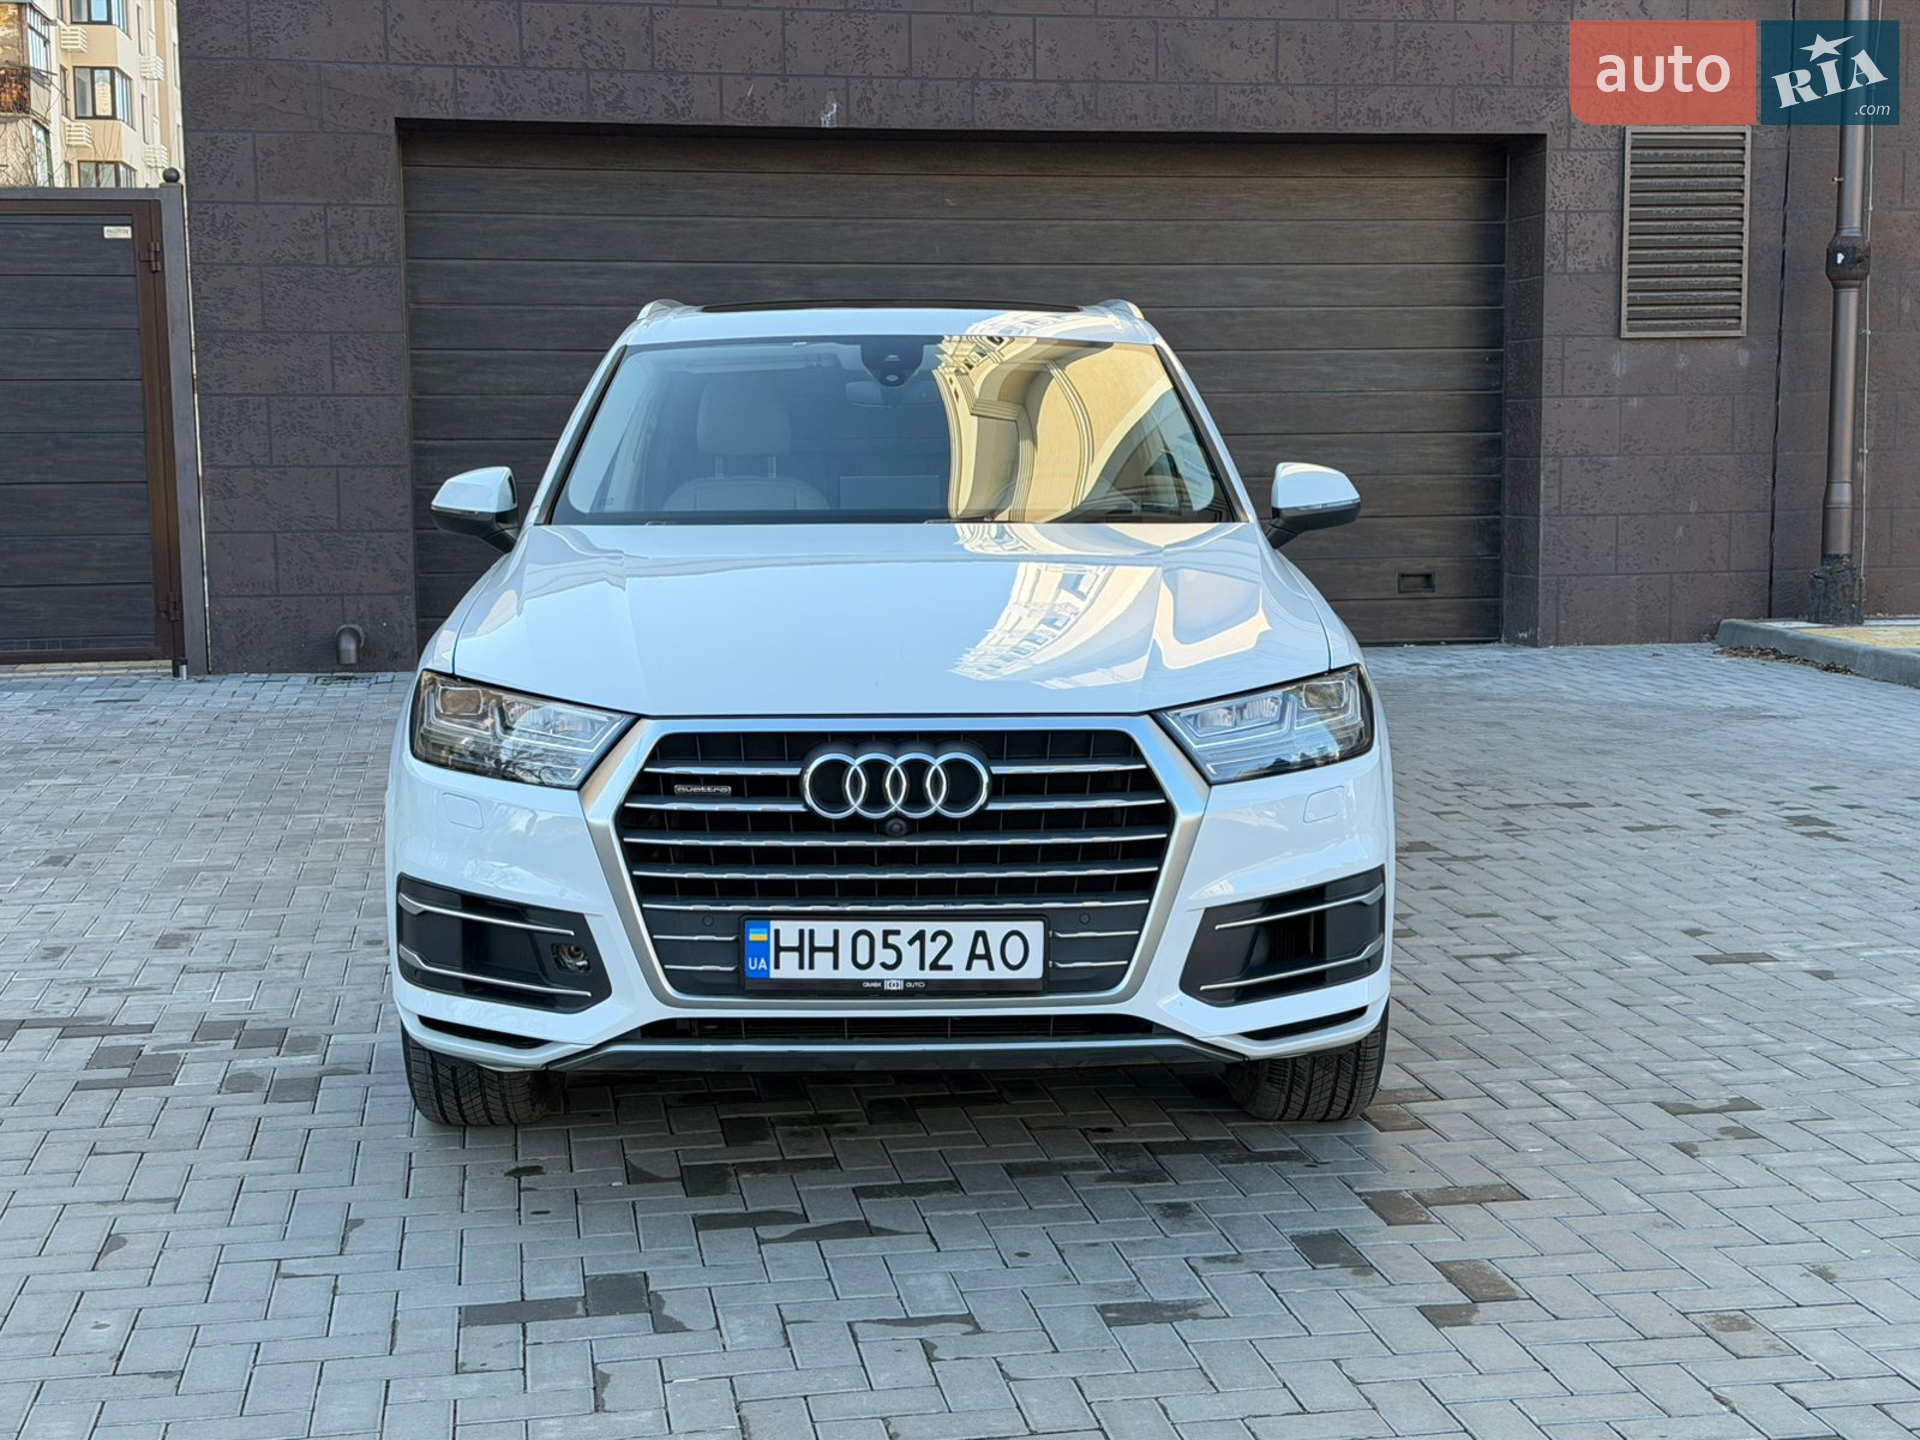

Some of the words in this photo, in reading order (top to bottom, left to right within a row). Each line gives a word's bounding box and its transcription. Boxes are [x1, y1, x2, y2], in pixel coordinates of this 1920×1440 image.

[748, 957, 768, 970] UA
[774, 928, 839, 970] HH
[851, 929, 953, 971] 0512
[965, 930, 1029, 971] AO
